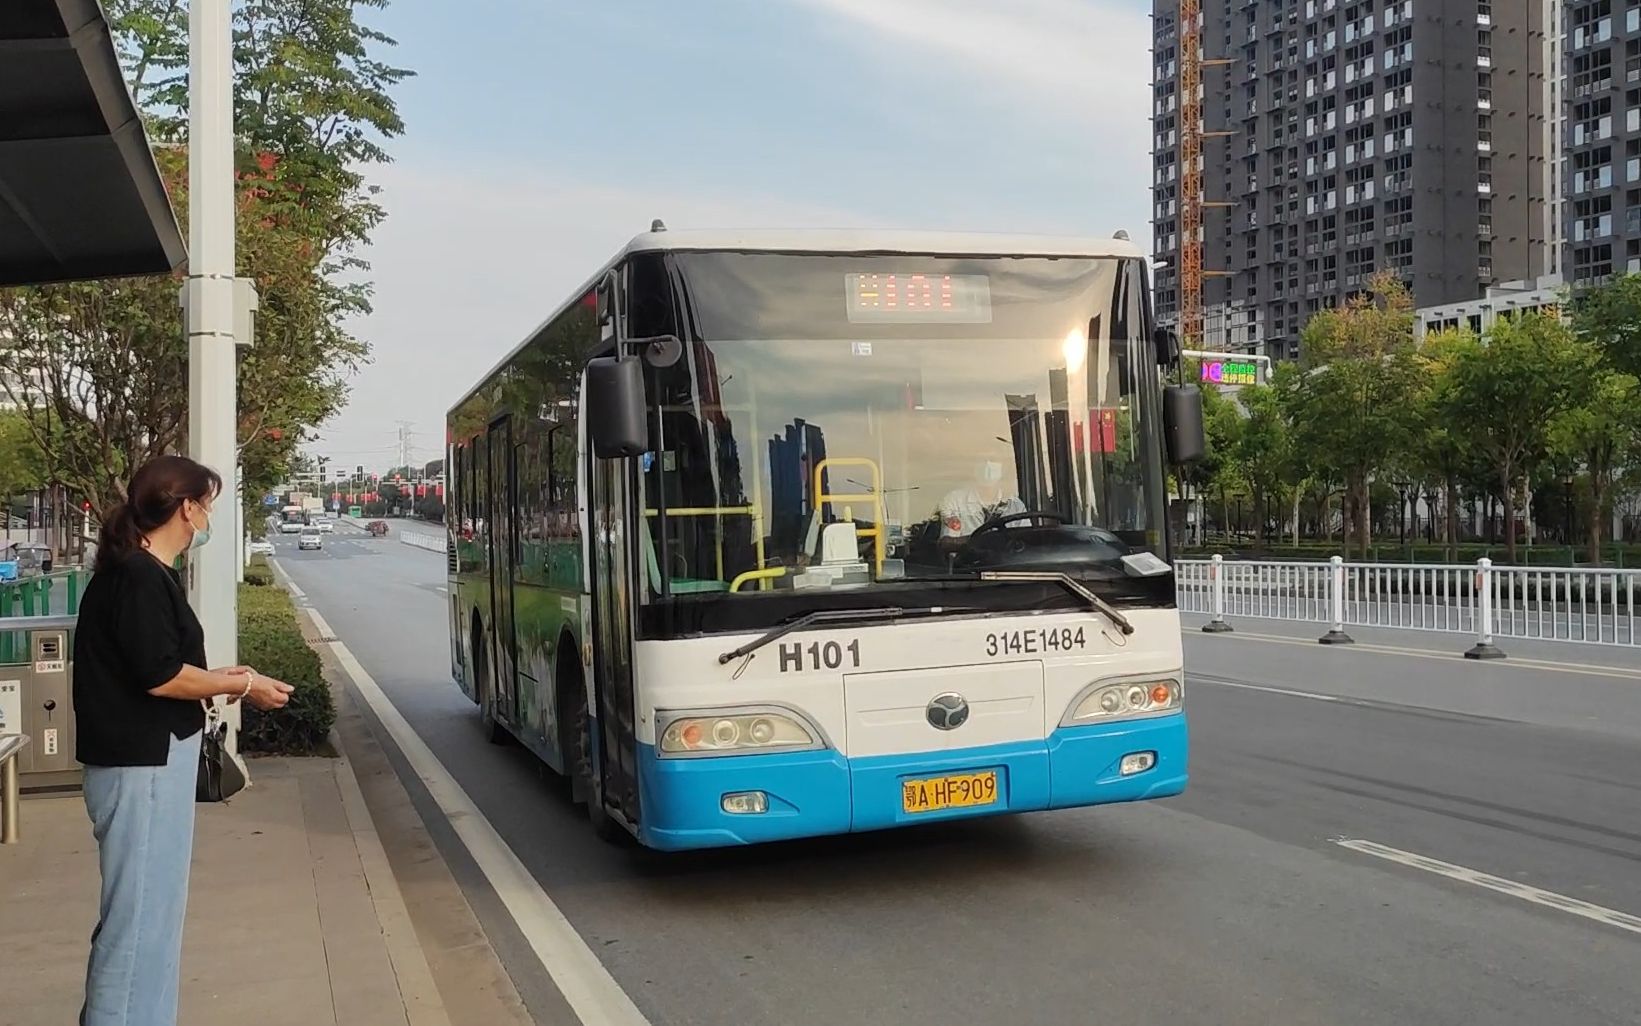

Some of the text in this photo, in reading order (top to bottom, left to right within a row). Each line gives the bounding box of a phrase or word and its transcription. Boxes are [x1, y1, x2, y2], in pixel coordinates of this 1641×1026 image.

[859, 274, 952, 308] H101
[778, 638, 860, 673] H101
[986, 626, 1086, 656] 314E1484
